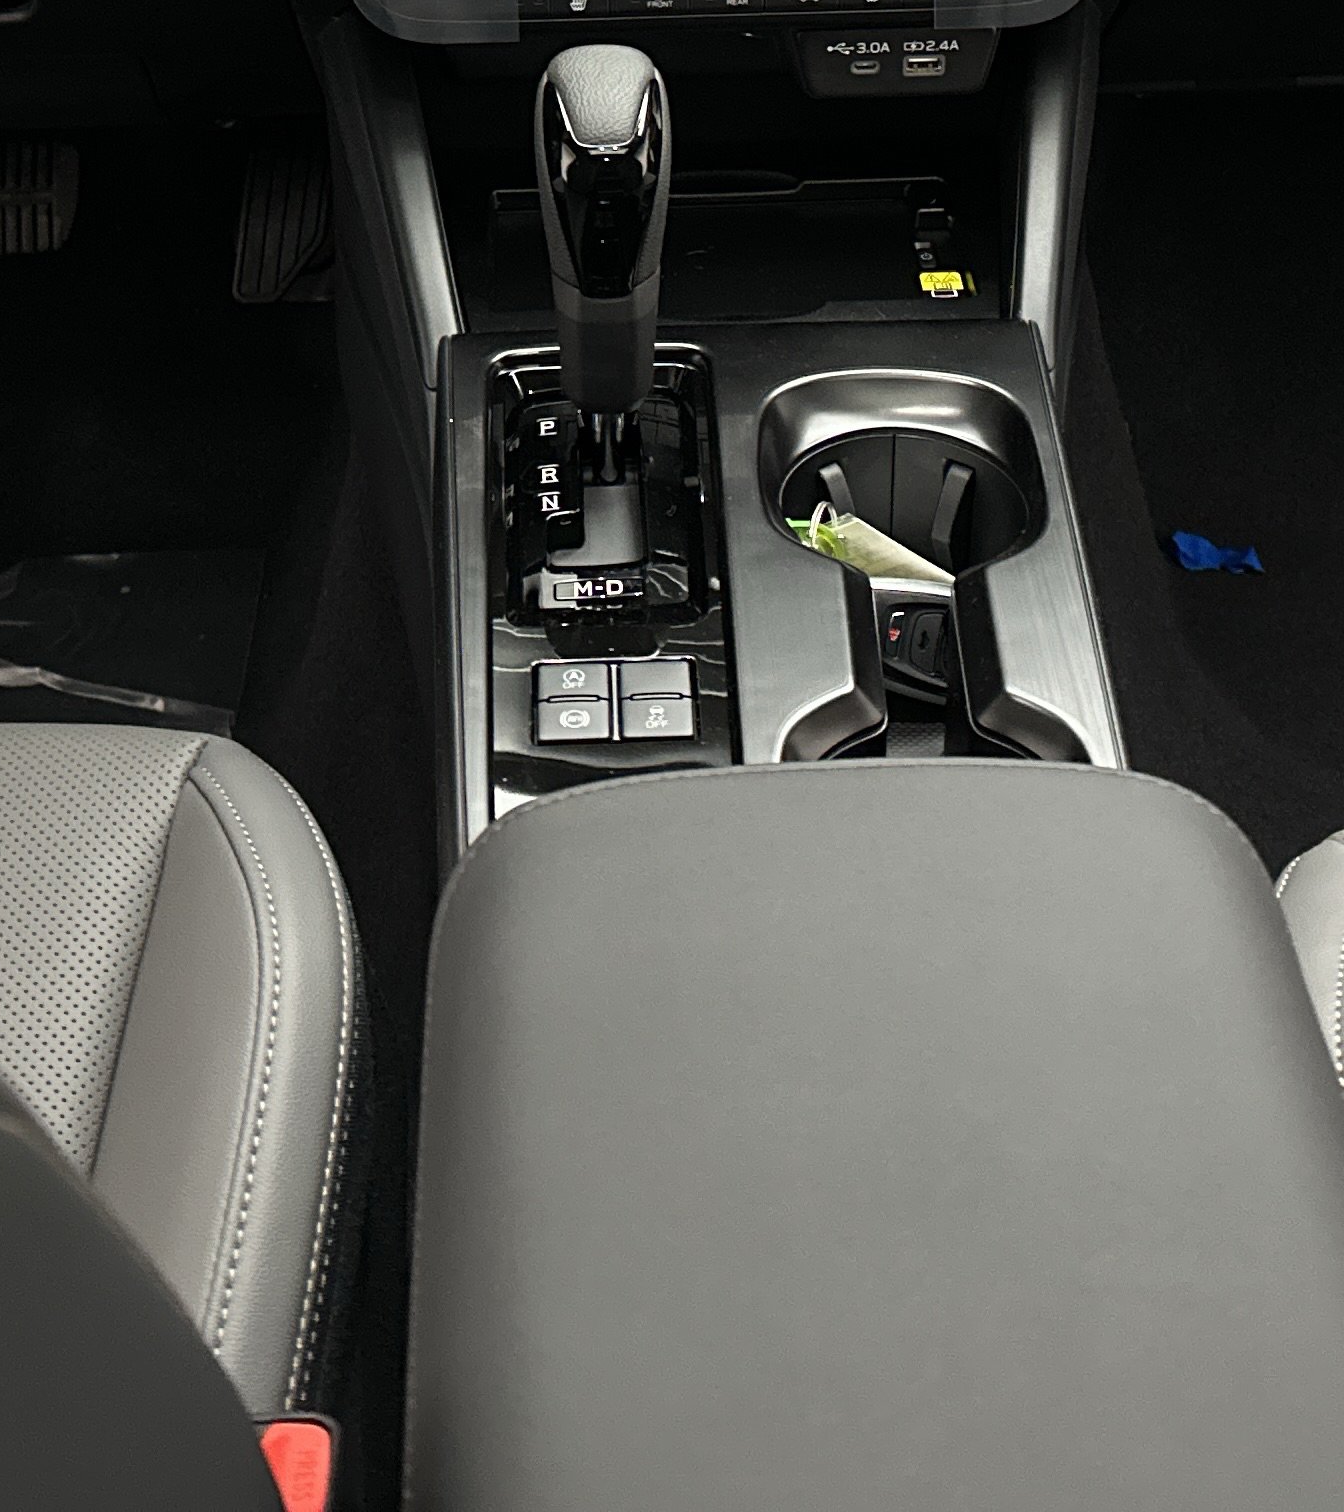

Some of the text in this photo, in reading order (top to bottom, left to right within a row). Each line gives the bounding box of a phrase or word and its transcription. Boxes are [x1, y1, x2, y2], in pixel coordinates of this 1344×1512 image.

[646, 0, 673, 8] FRONT
[856, 41, 890, 54] 3.0A
[925, 40, 959, 52] 2.4A
[539, 420, 557, 436] P
[540, 467, 559, 484] R
[541, 495, 560, 512] N
